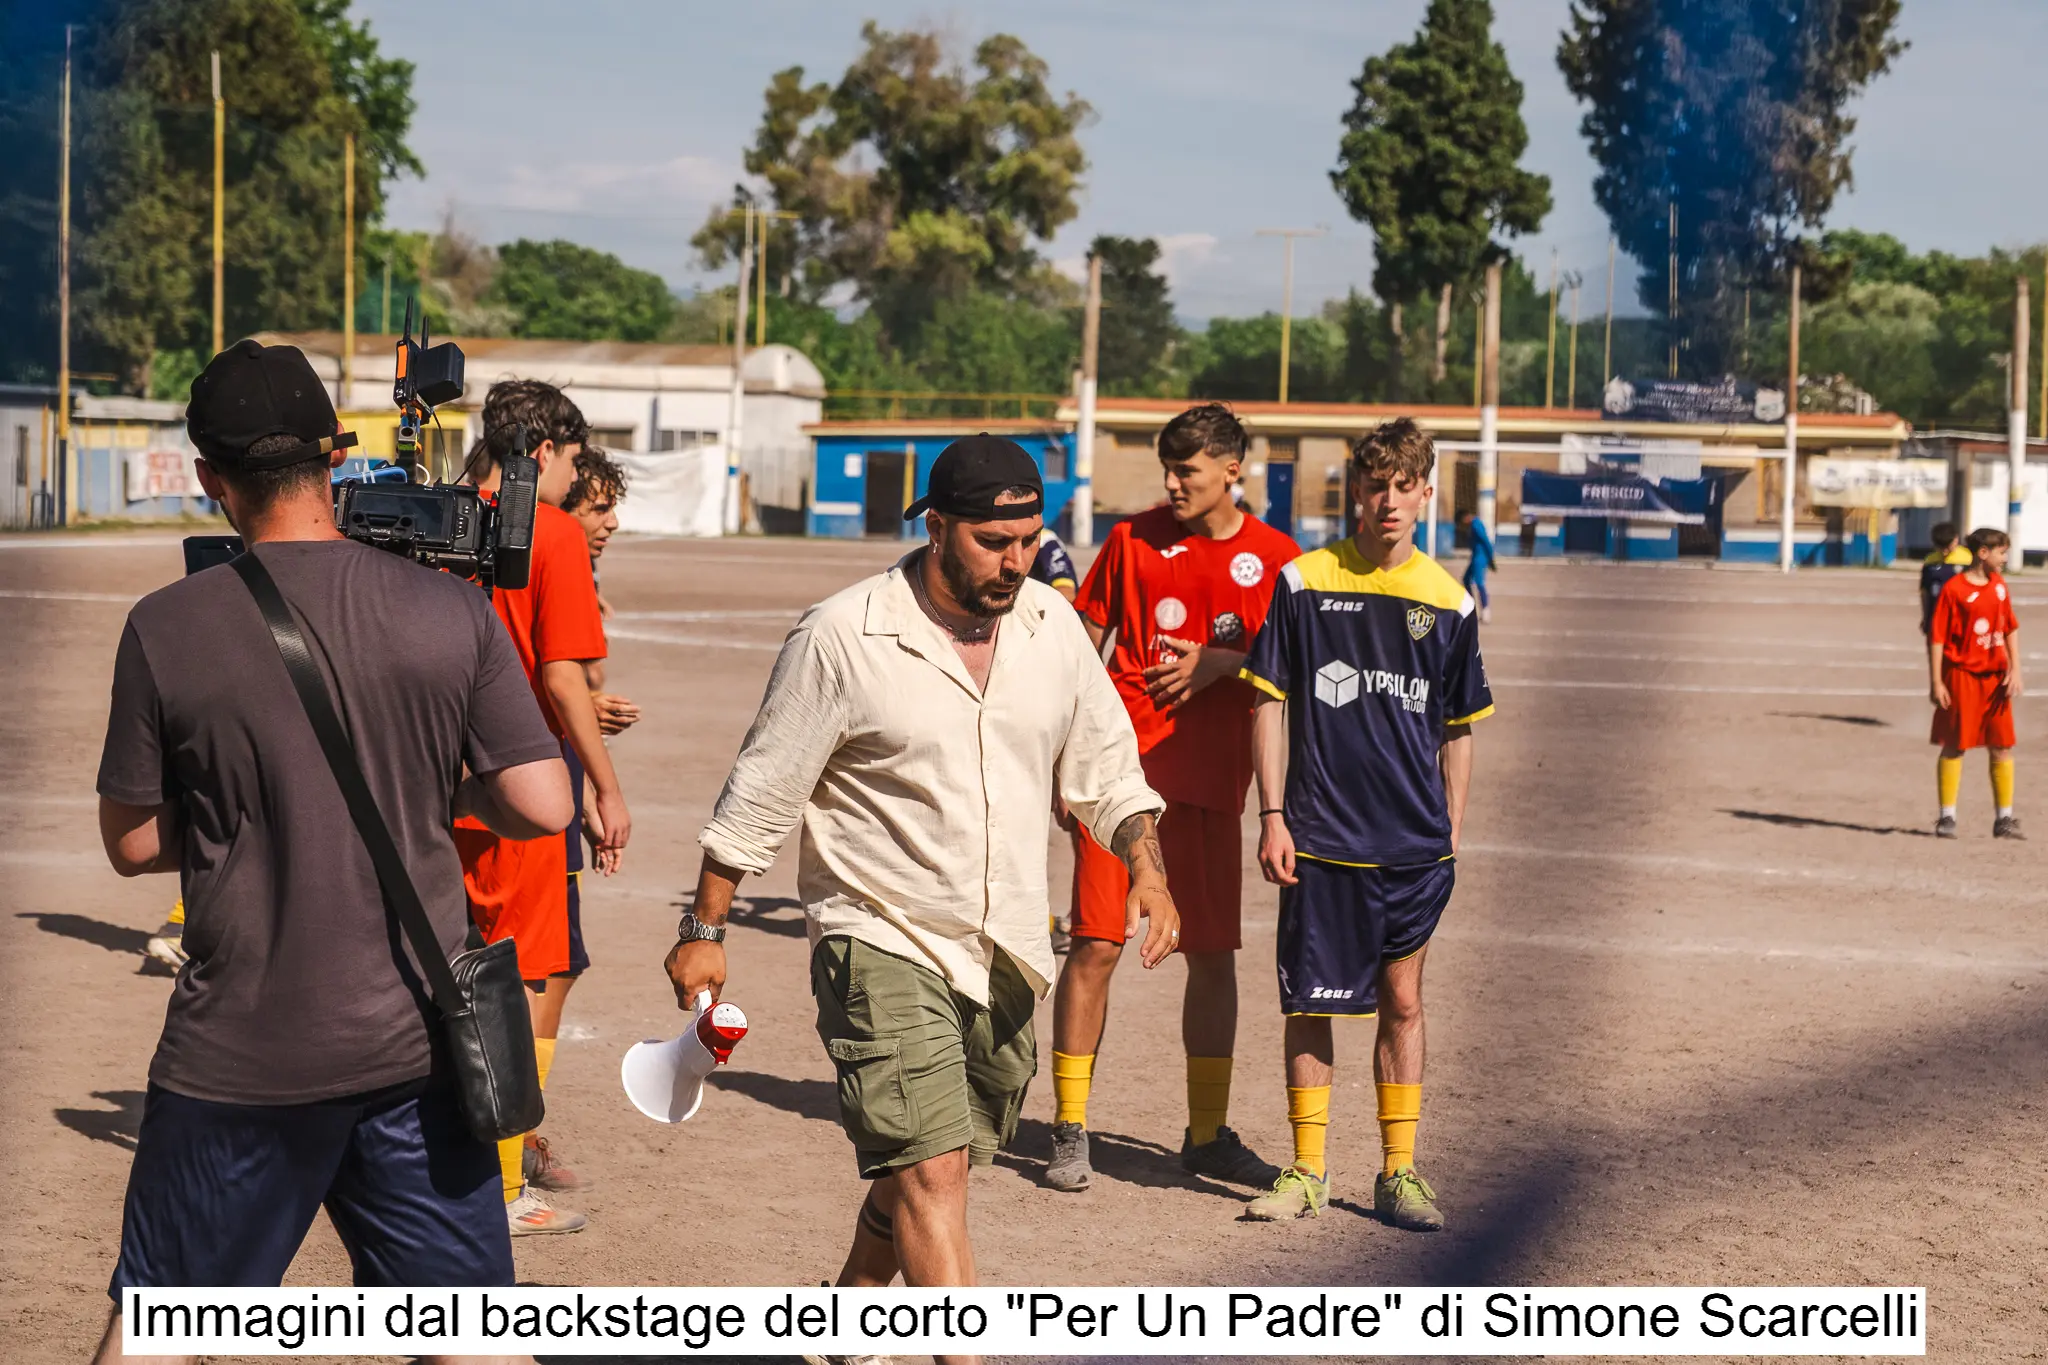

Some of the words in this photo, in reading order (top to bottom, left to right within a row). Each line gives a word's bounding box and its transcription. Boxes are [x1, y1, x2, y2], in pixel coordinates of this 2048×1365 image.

[370, 527, 391, 535] SmallRig
[1319, 598, 1365, 612] Zeus
[1362, 669, 1430, 703] YPSILON
[1309, 986, 1354, 999] Zeus
